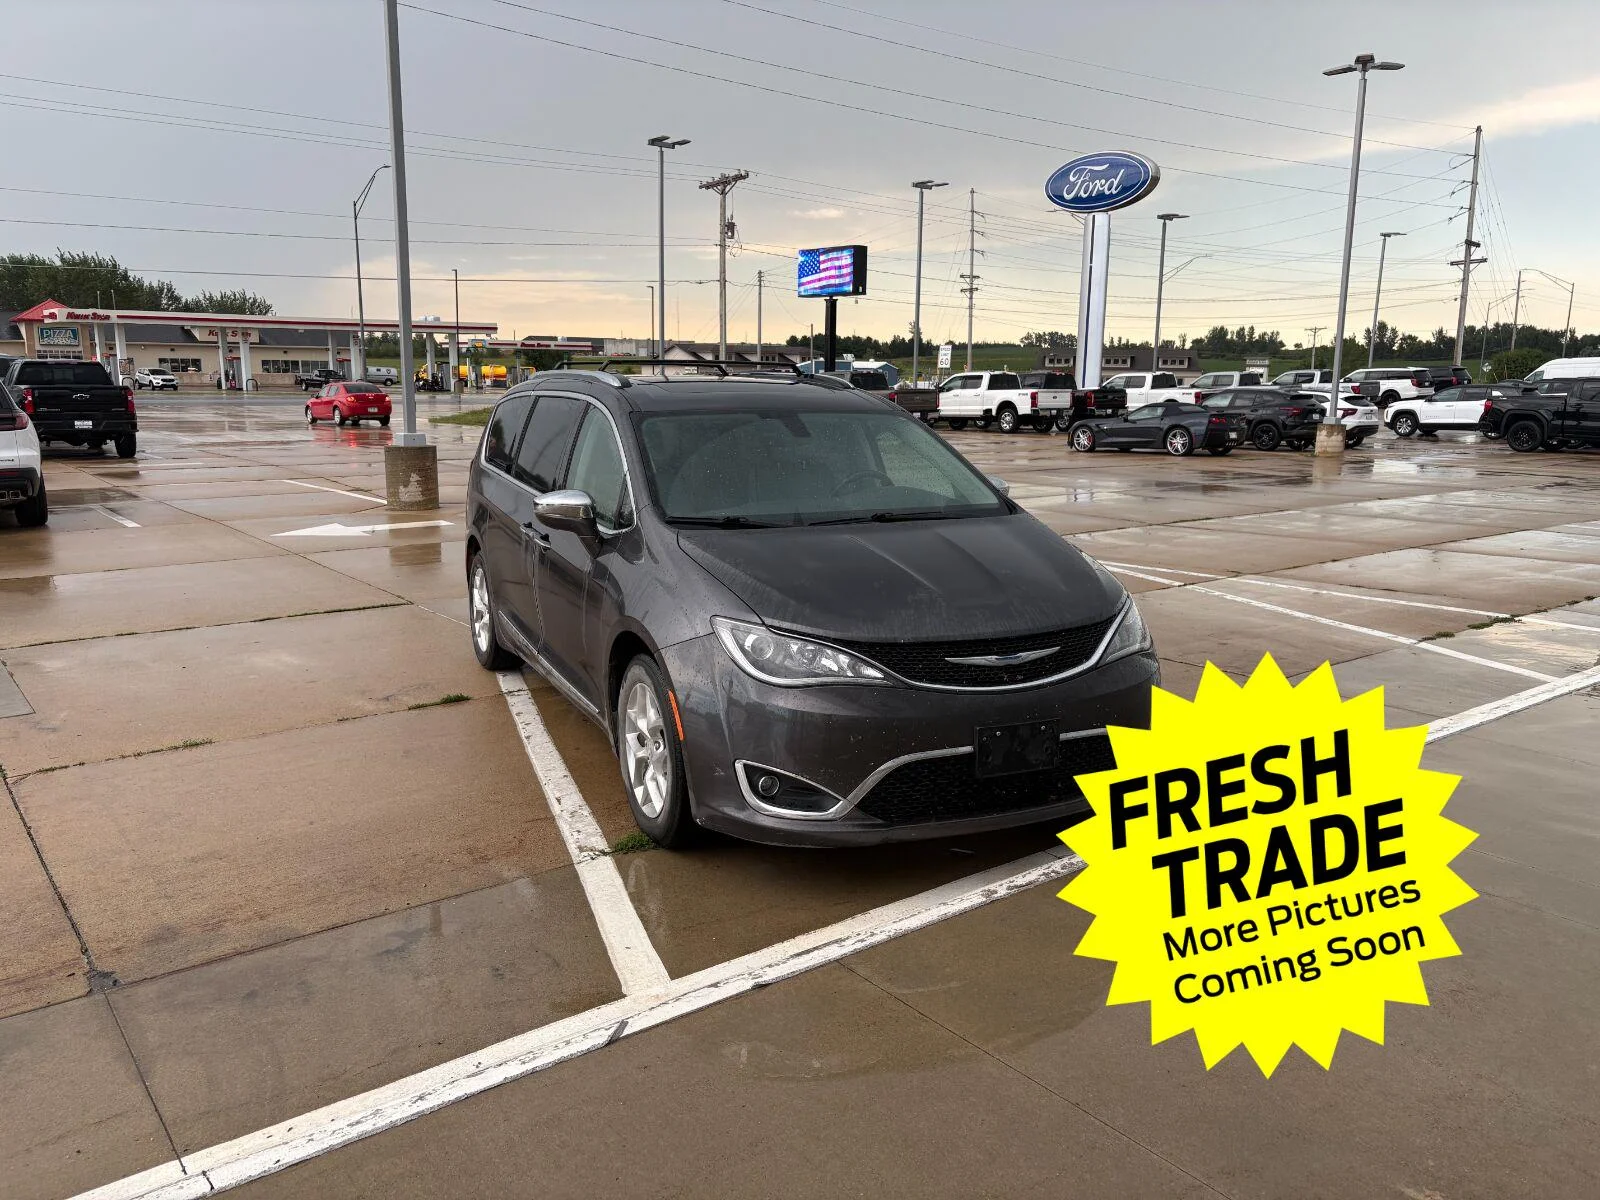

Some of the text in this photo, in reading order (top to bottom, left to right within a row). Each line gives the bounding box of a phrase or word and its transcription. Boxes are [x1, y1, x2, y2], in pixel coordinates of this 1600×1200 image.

[1063, 163, 1125, 200] Ford
[43, 329, 74, 338] PIZZA
[940, 358, 948, 366] 60
